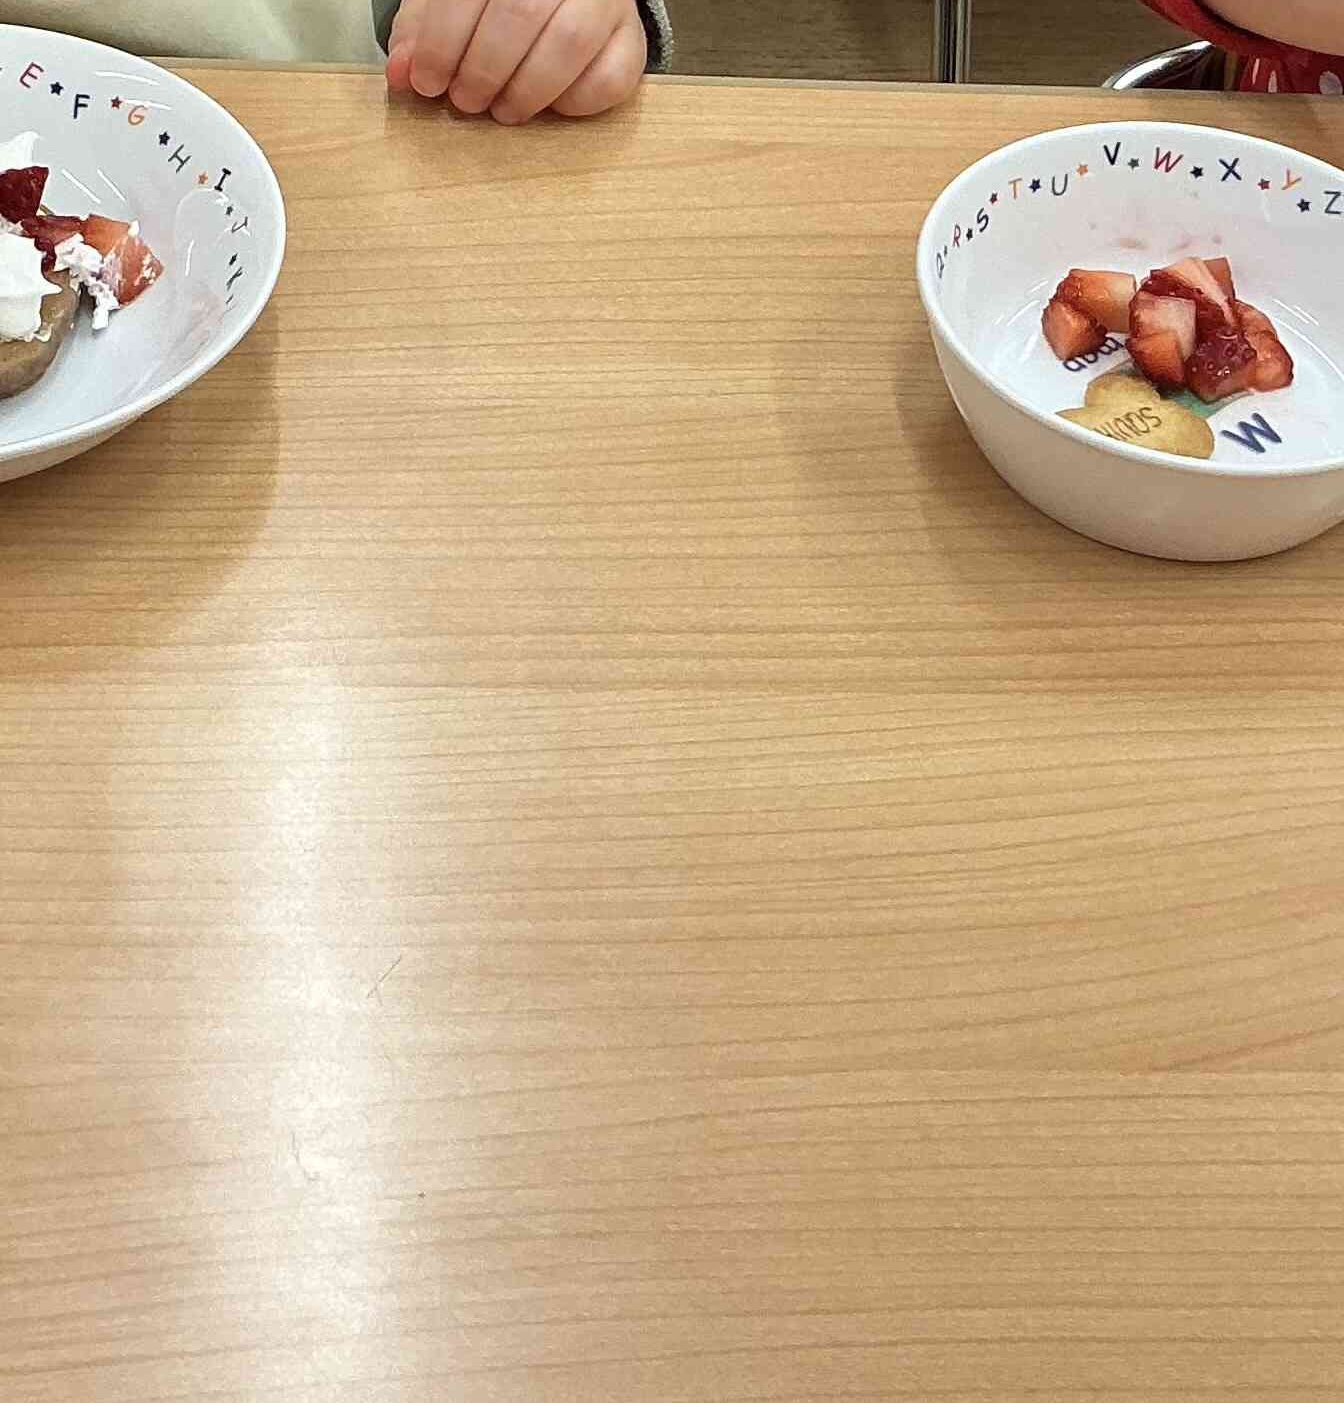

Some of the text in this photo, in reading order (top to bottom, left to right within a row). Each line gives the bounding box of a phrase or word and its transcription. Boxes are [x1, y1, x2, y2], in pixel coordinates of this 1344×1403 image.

[18, 61, 45, 89] E
[73, 93, 91, 119] F
[127, 105, 148, 126] G
[167, 144, 192, 174] H
[213, 167, 232, 192] I
[951, 223, 962, 248] R
[976, 207, 990, 233] S
[1007, 177, 1023, 200] T
[1050, 173, 1068, 197] U
[1103, 141, 1121, 166] V
[1153, 147, 1184, 173] W
[1218, 157, 1243, 182] X
[1281, 168, 1303, 191] Y
[1323, 191, 1343, 215] Z
